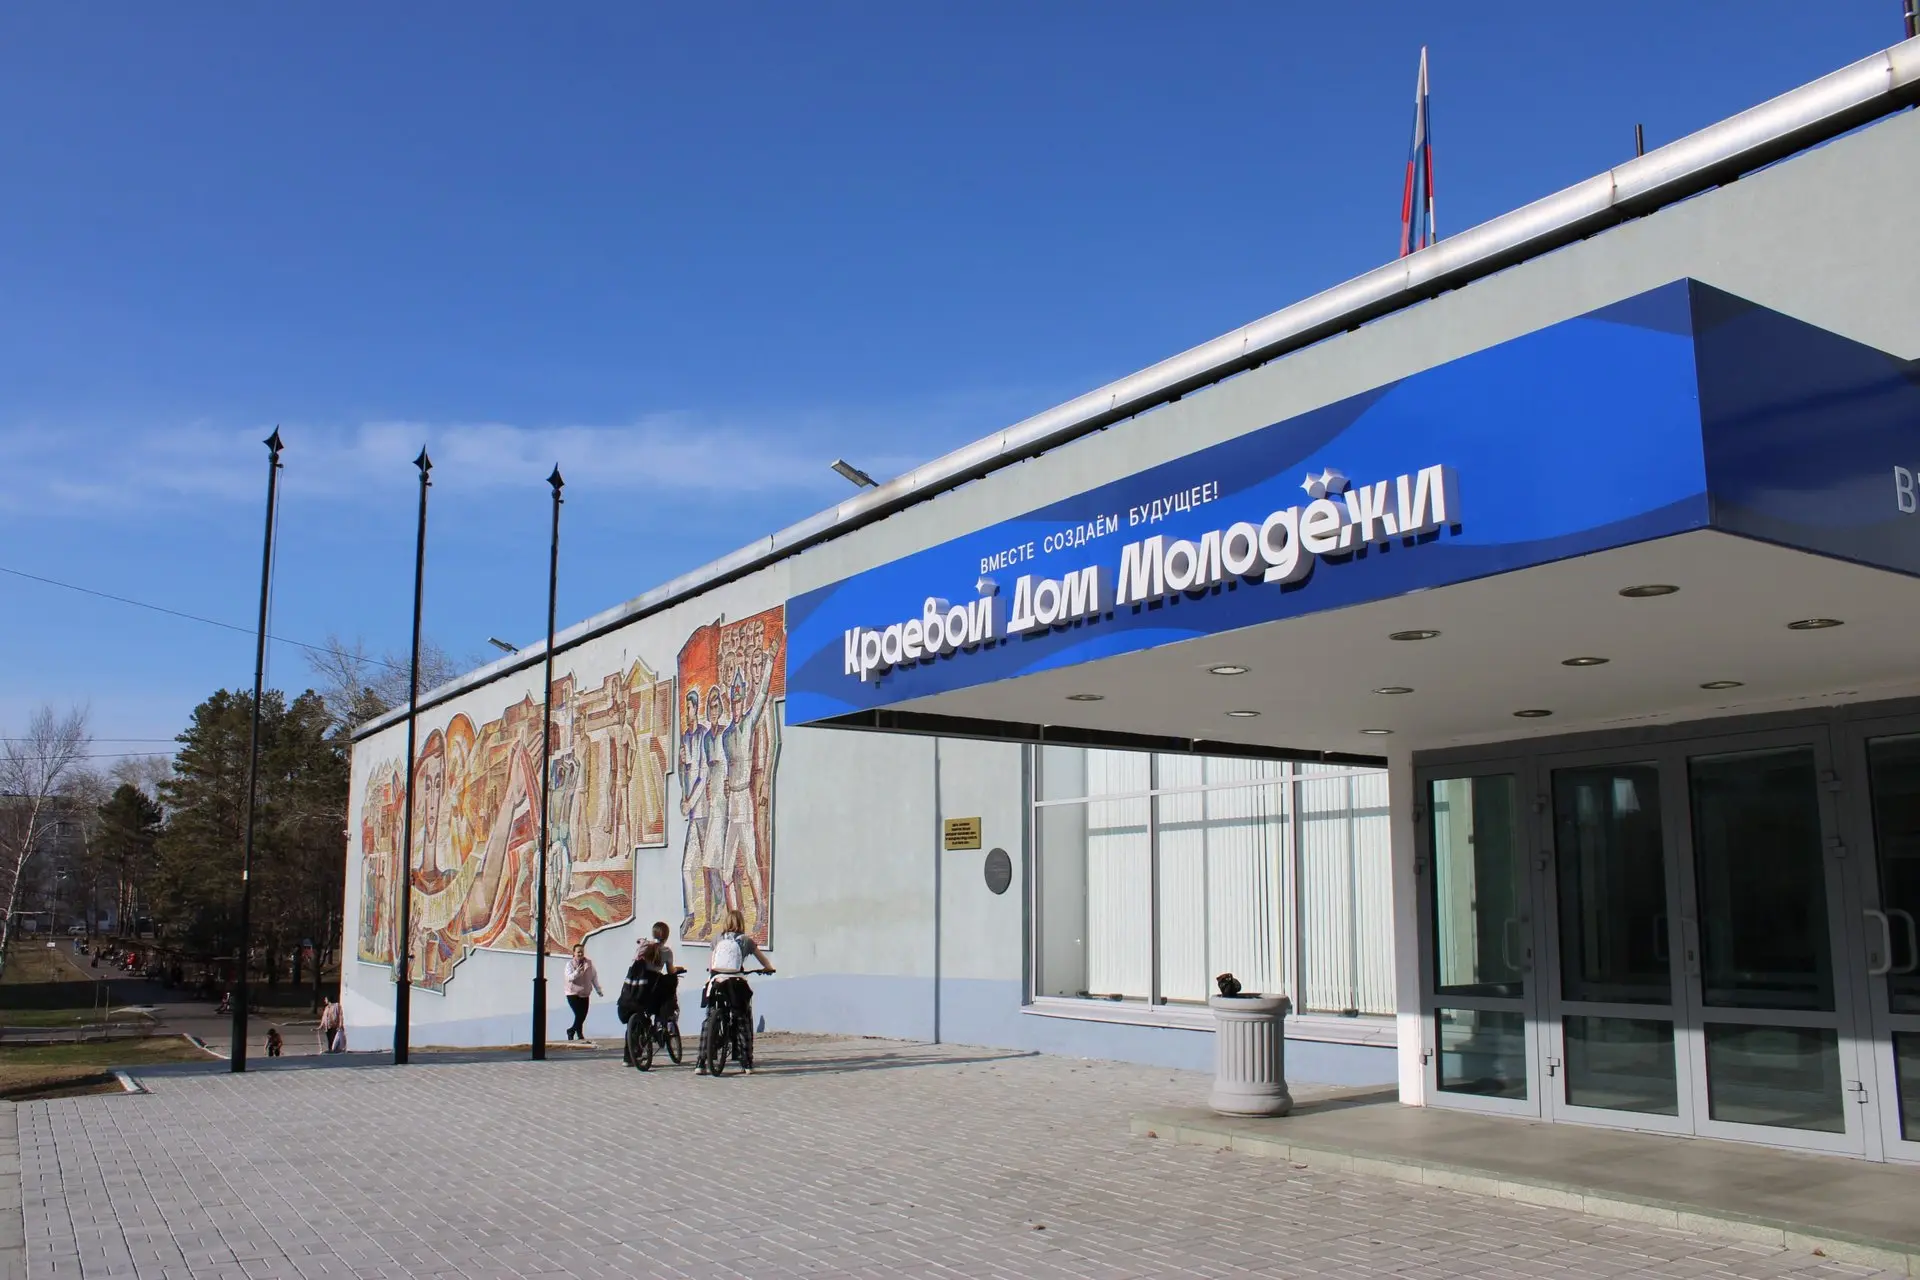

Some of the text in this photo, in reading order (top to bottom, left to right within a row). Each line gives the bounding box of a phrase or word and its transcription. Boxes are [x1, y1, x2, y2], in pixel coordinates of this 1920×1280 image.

[844, 464, 1448, 682] Краевой Дом Молодёжи
[980, 480, 1219, 574] ВМЕСТЕ СОЗДАЁМ БУДУЩЕЕ!
